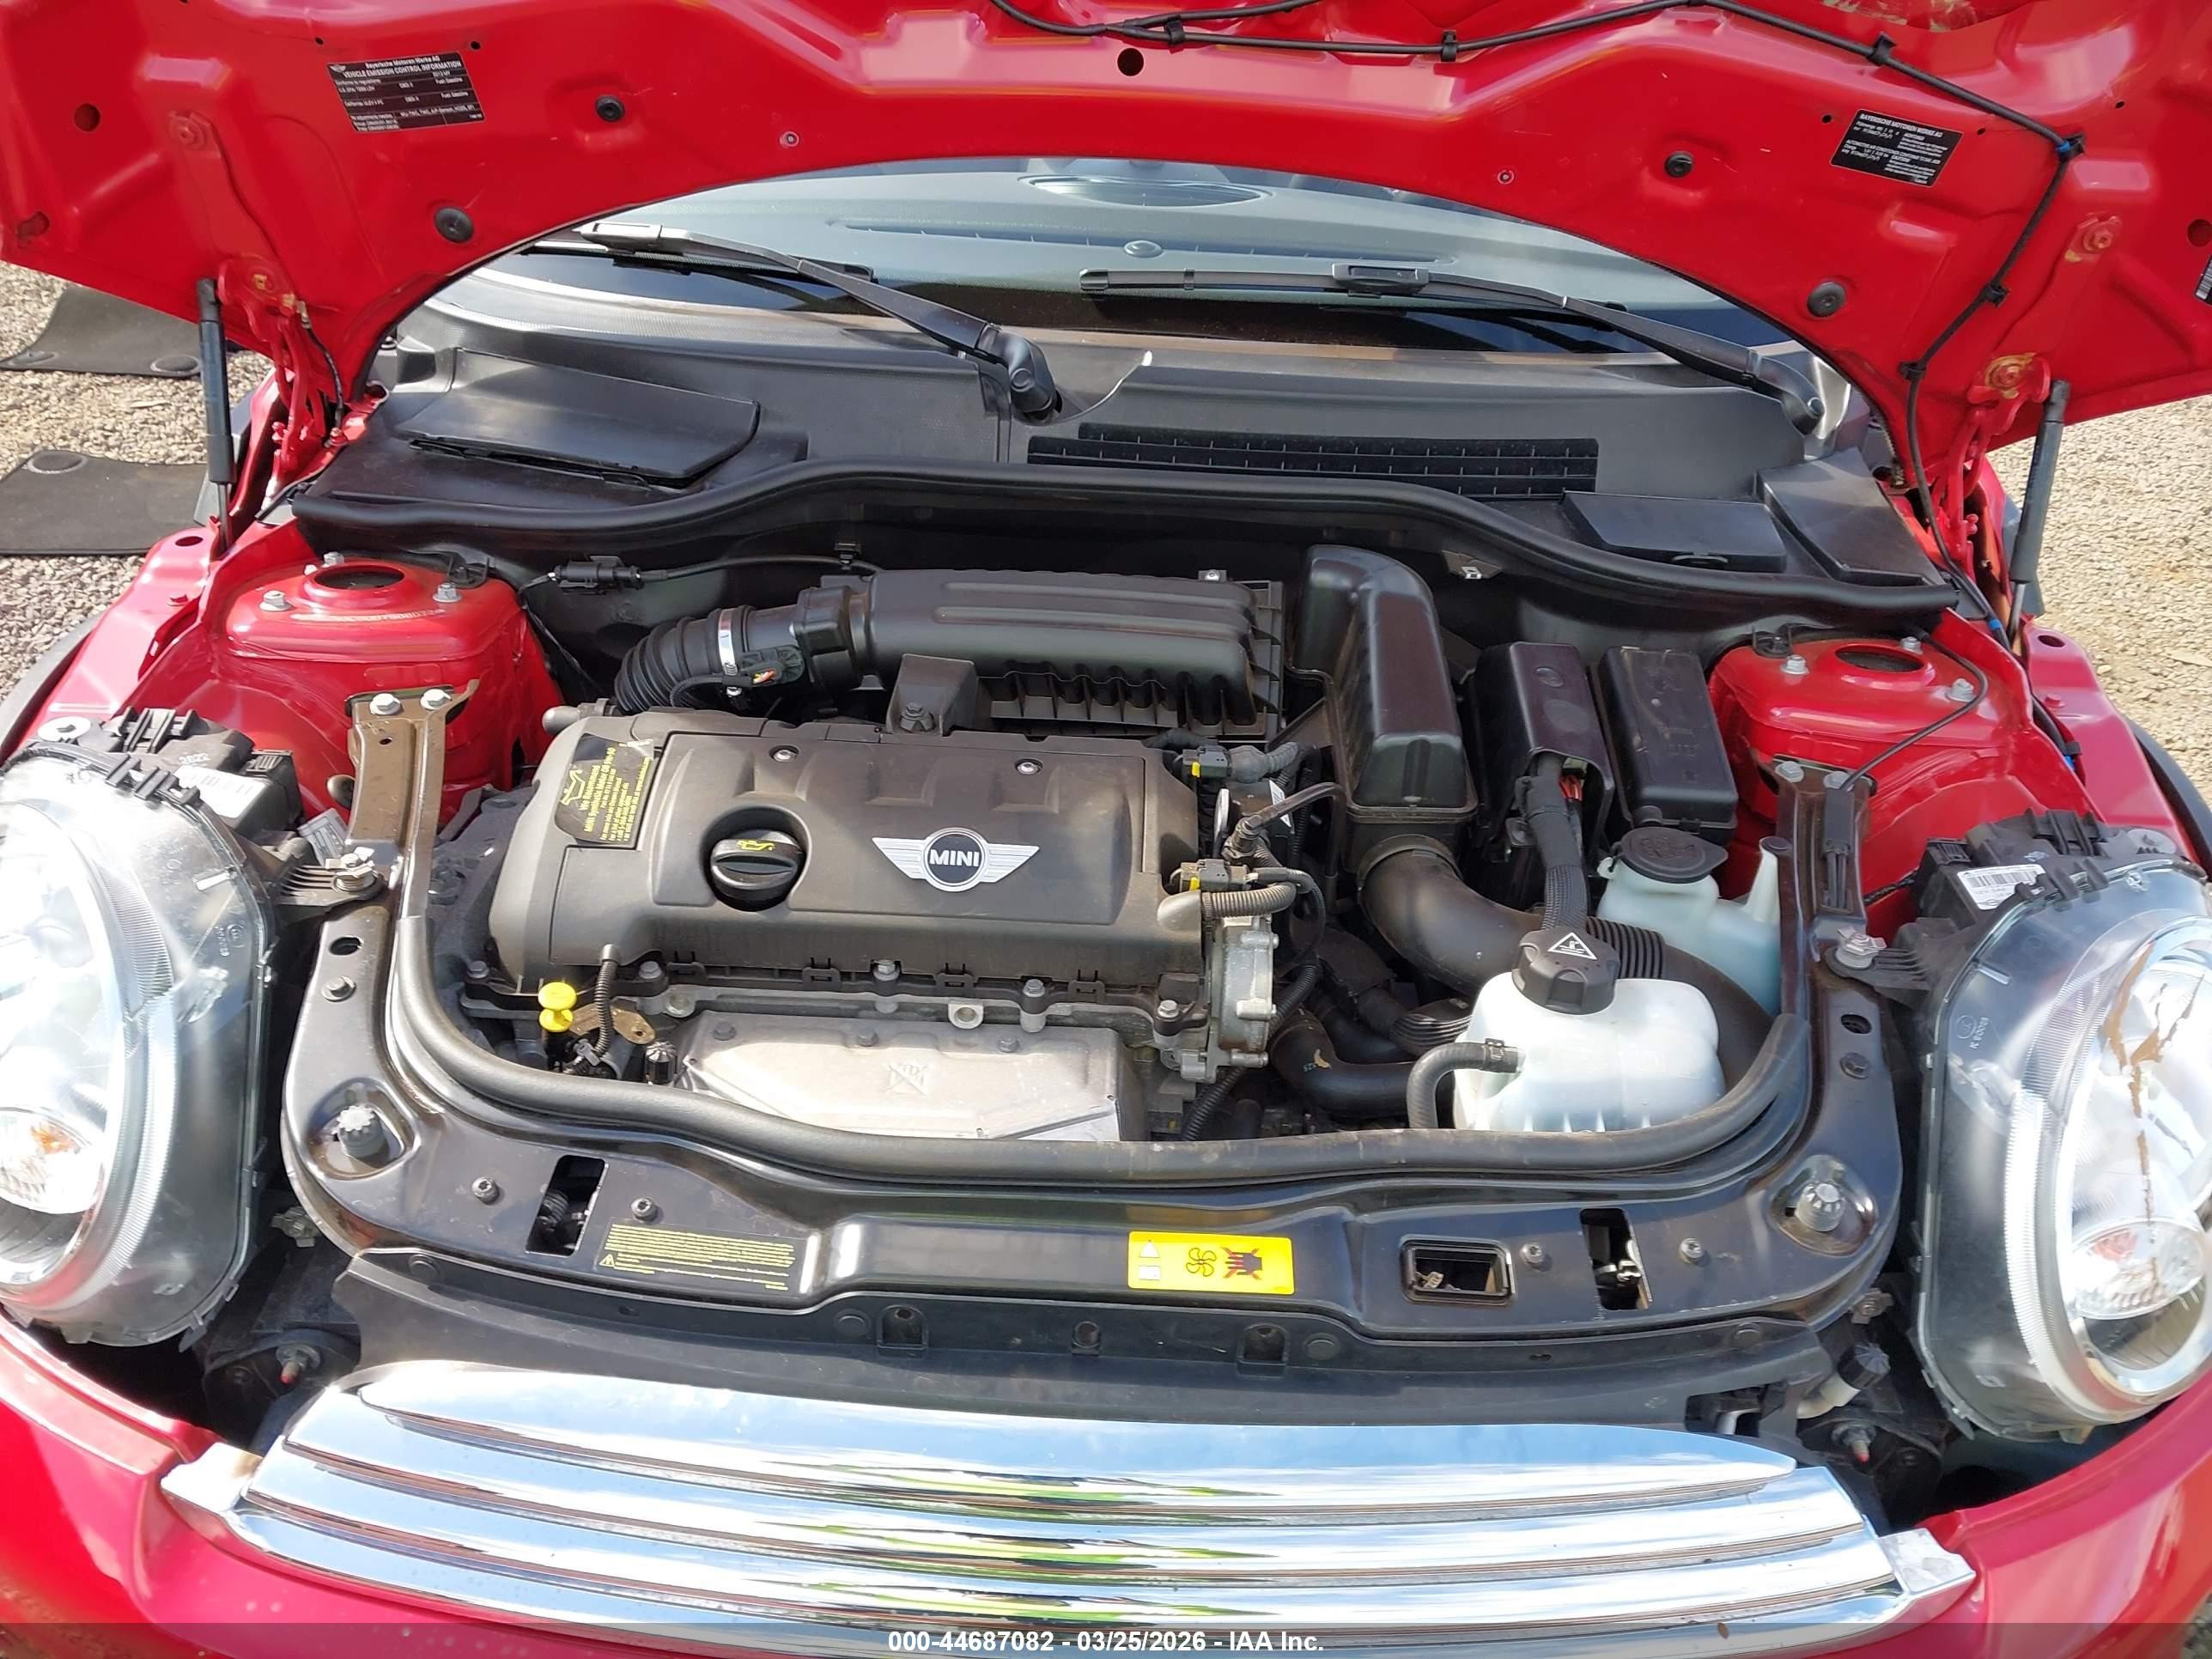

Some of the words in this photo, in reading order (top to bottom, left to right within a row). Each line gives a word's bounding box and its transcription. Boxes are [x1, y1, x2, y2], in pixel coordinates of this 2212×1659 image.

[366, 68, 395, 76] EMISSION
[394, 65, 422, 74] CONTROL
[421, 61, 461, 70] INFORMATION
[584, 817, 595, 832] MINI
[930, 848, 980, 867] MINI
